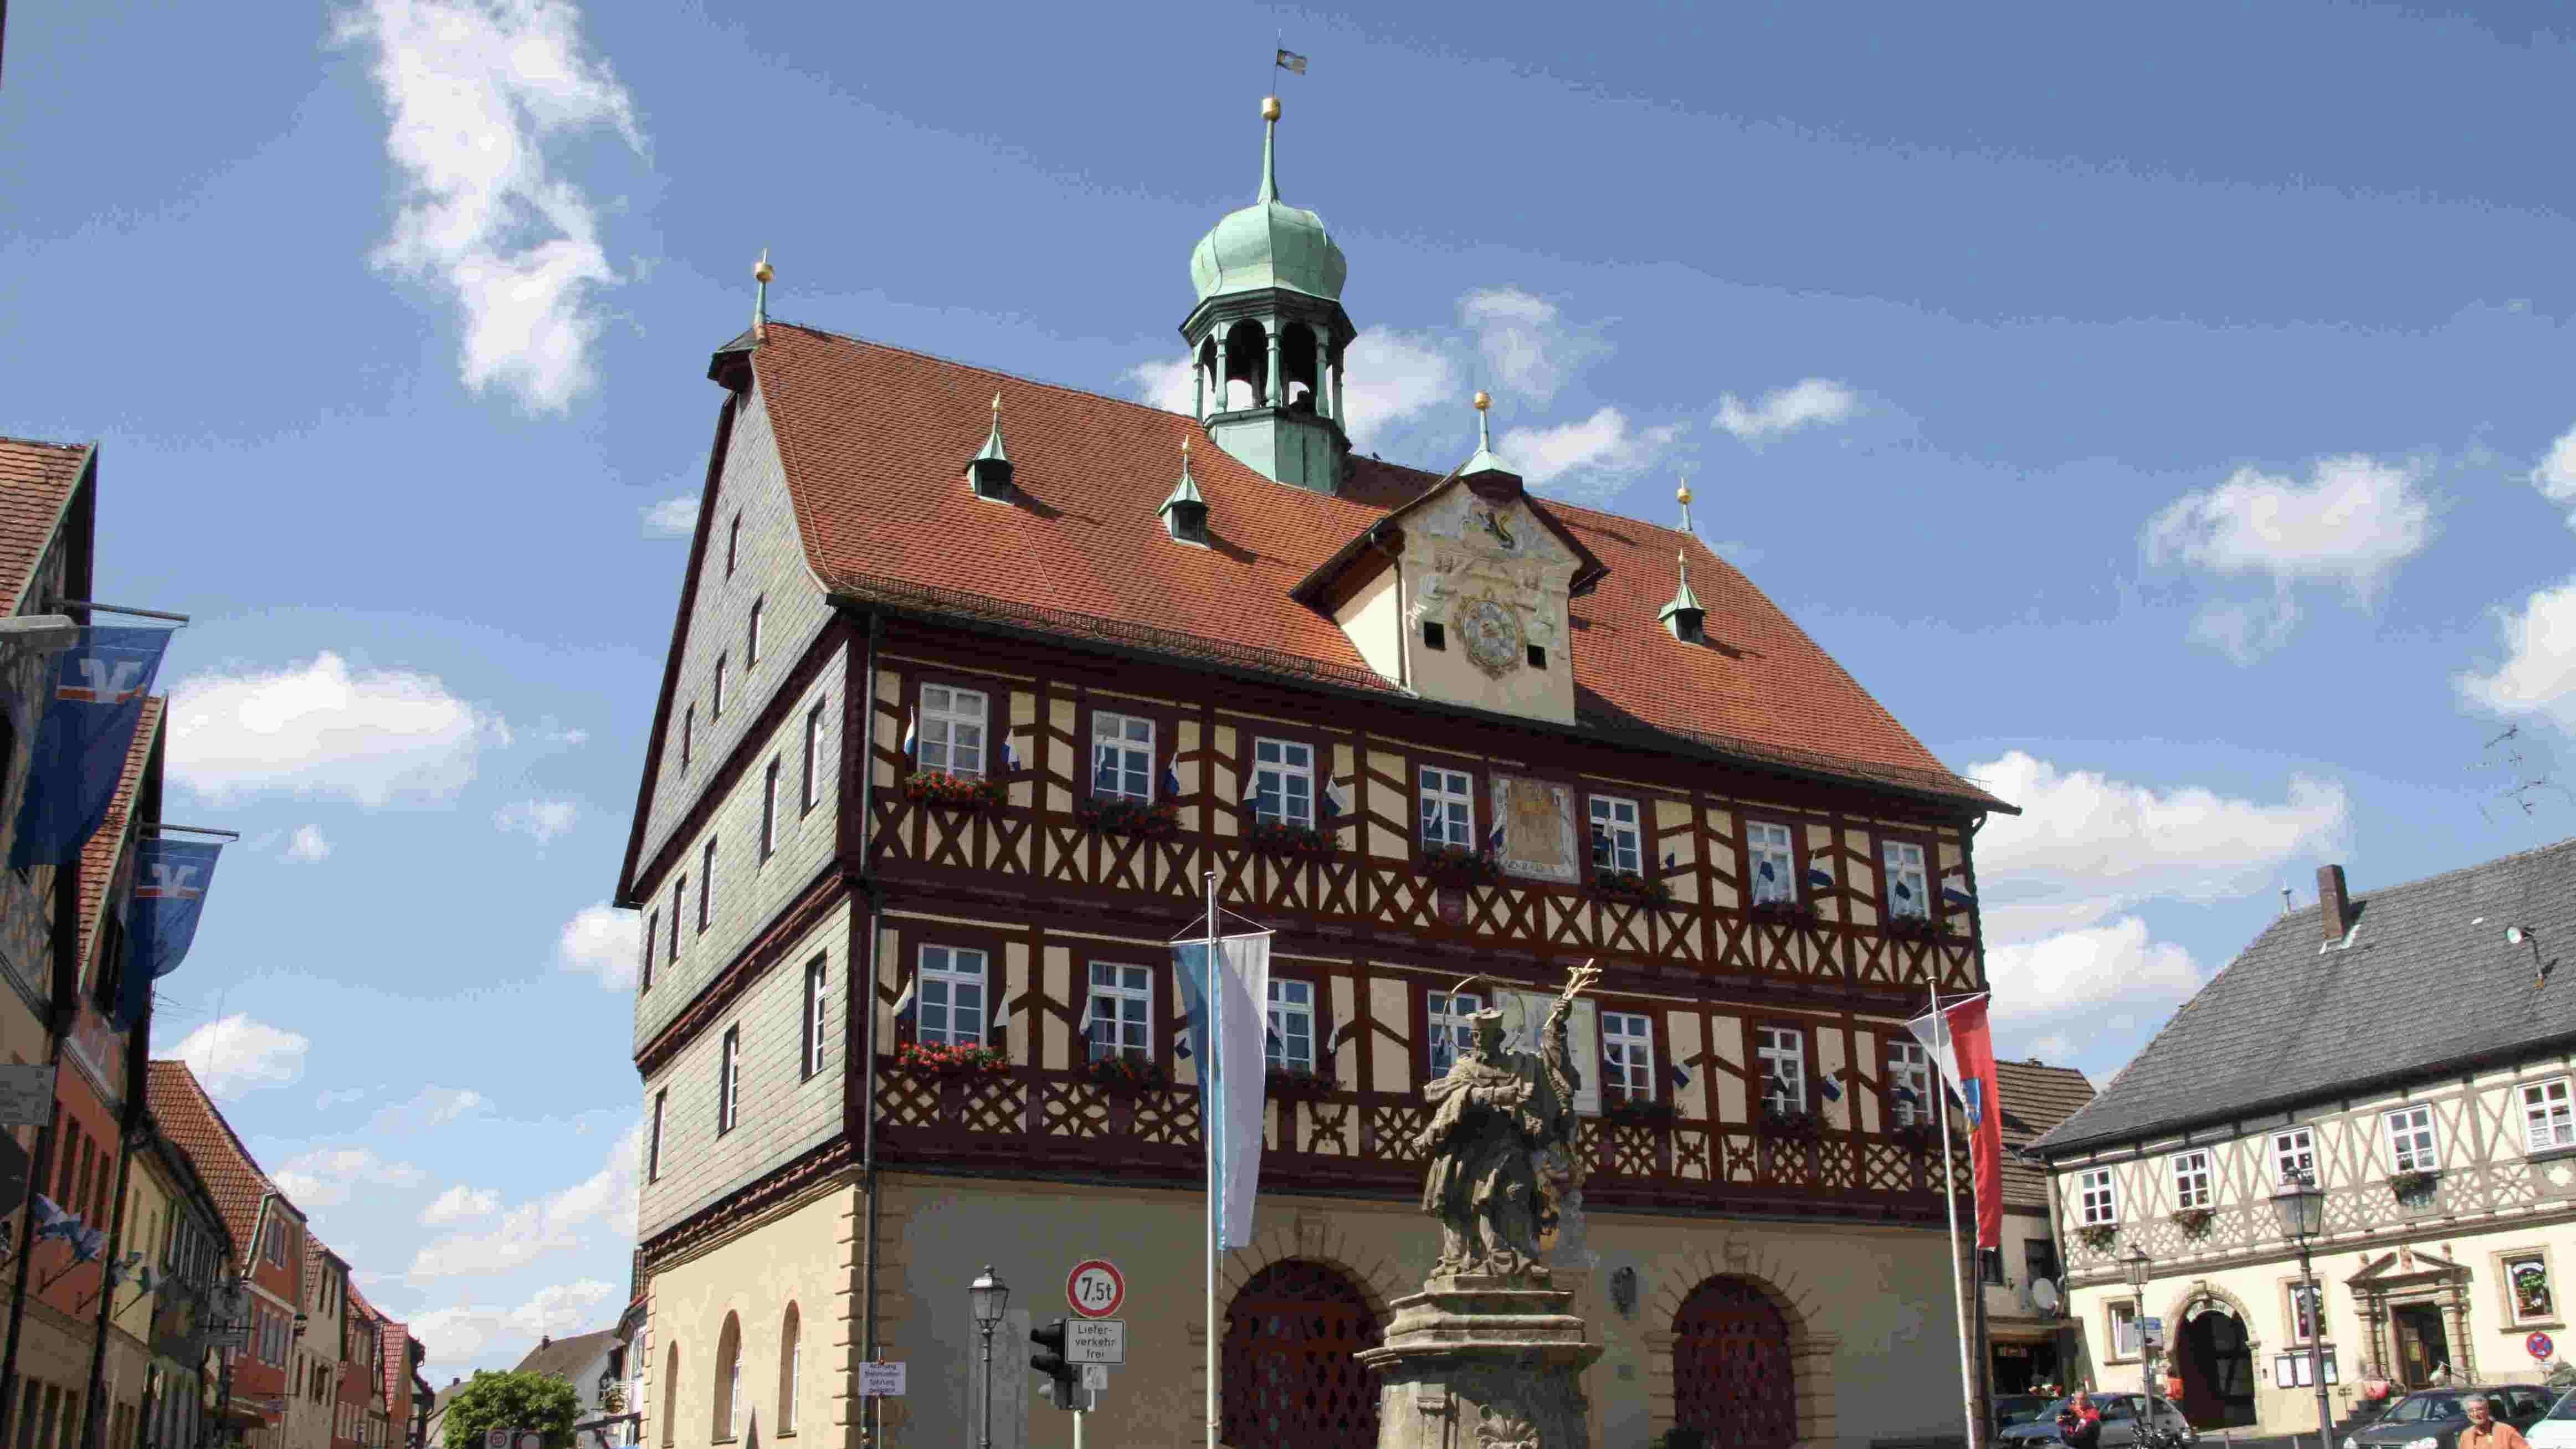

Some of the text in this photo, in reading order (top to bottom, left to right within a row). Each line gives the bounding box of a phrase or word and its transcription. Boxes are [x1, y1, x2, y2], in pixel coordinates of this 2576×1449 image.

[1077, 1324, 1113, 1334] Liefer-
[1075, 1337, 1117, 1347] verkehr
[1086, 1348, 1104, 1359] frei
